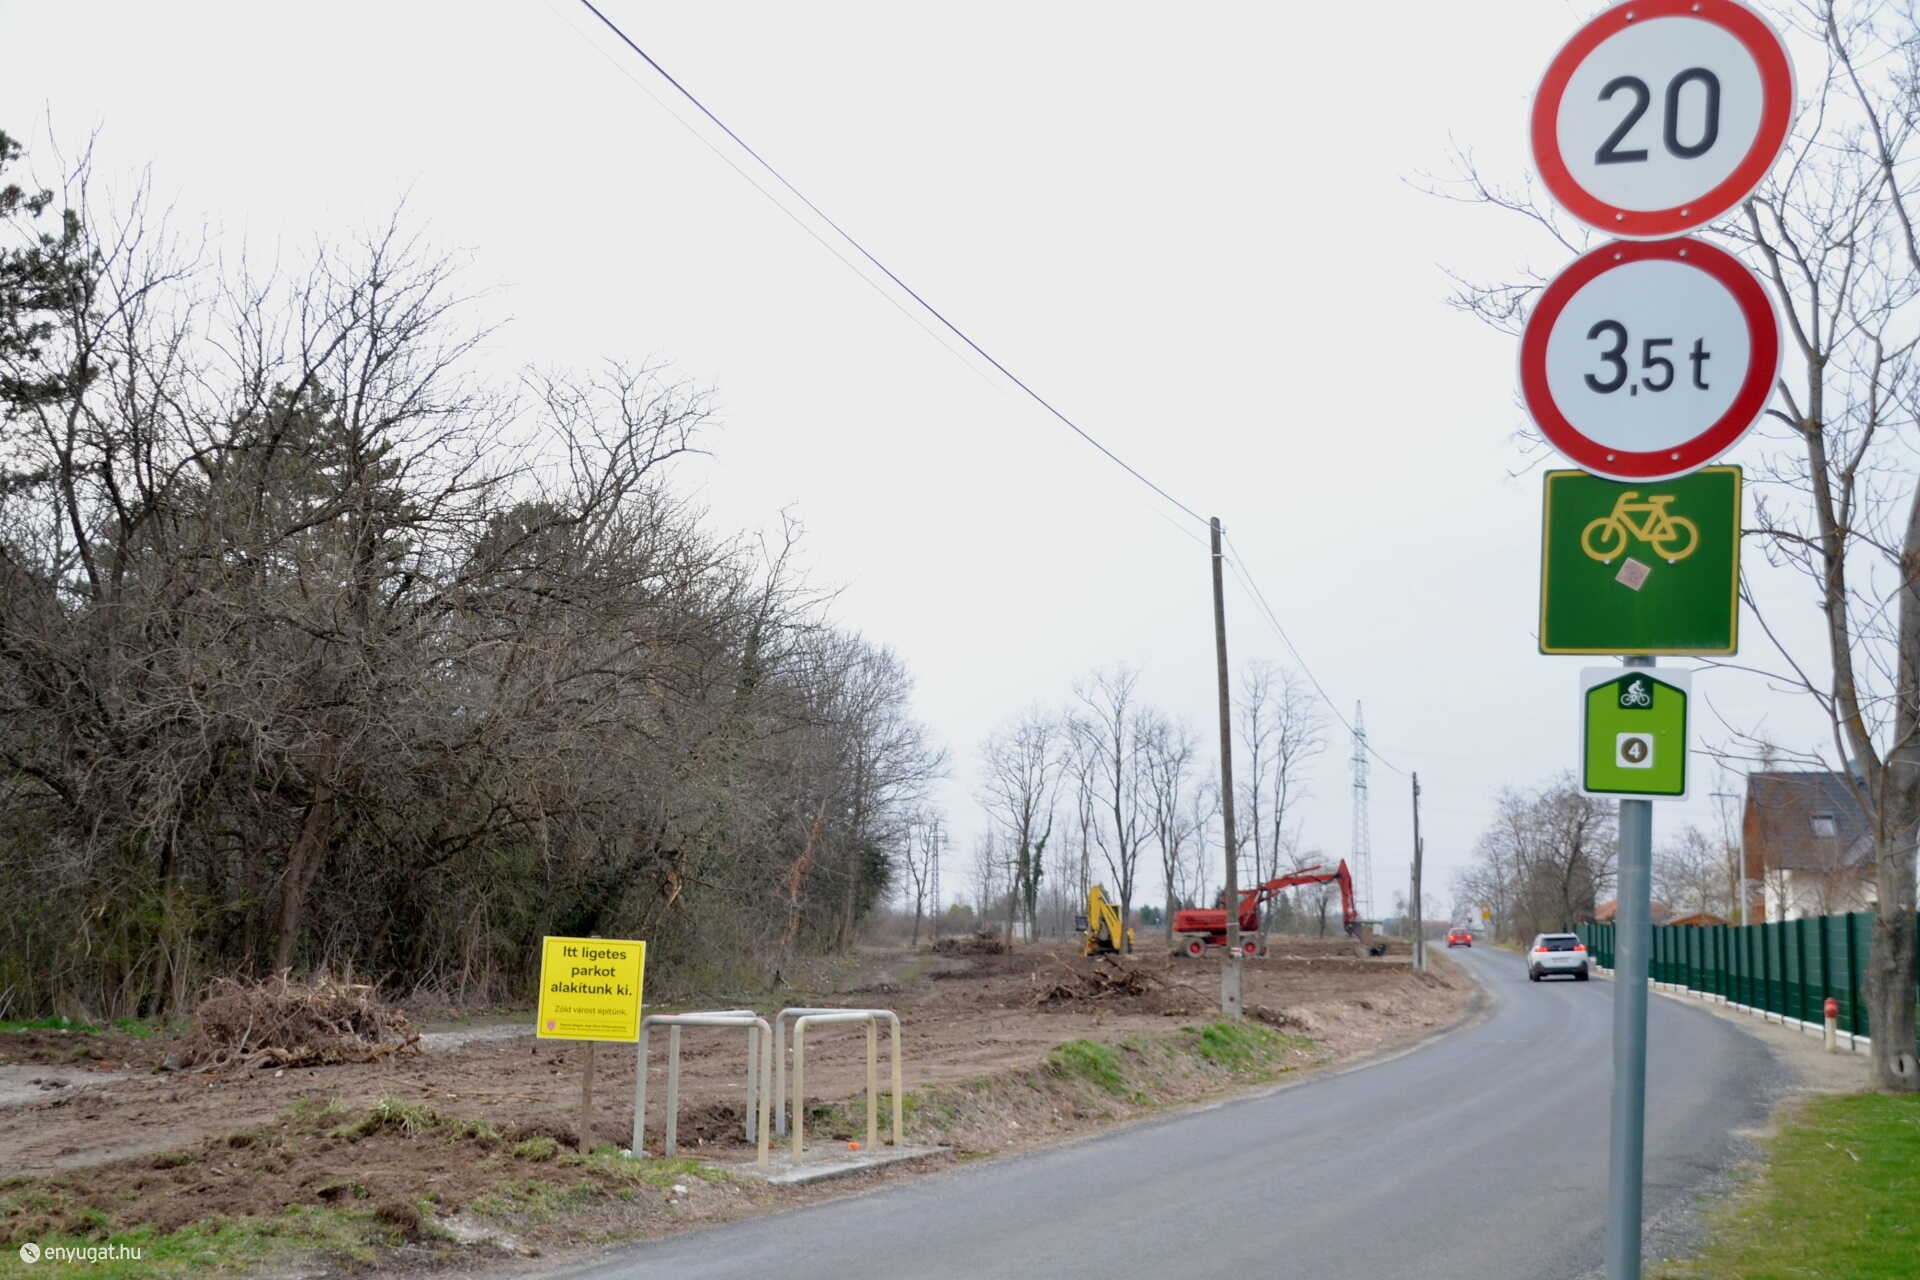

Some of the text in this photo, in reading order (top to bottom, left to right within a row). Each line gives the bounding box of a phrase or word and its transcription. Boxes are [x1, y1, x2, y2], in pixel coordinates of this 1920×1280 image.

[1594, 66, 1721, 166] 20
[1583, 319, 1711, 397] 3,5 t
[1628, 742, 1641, 760] 4
[563, 946, 627, 961] Itt ligetes
[571, 965, 616, 978] parkot
[616, 984, 632, 996] ki.
